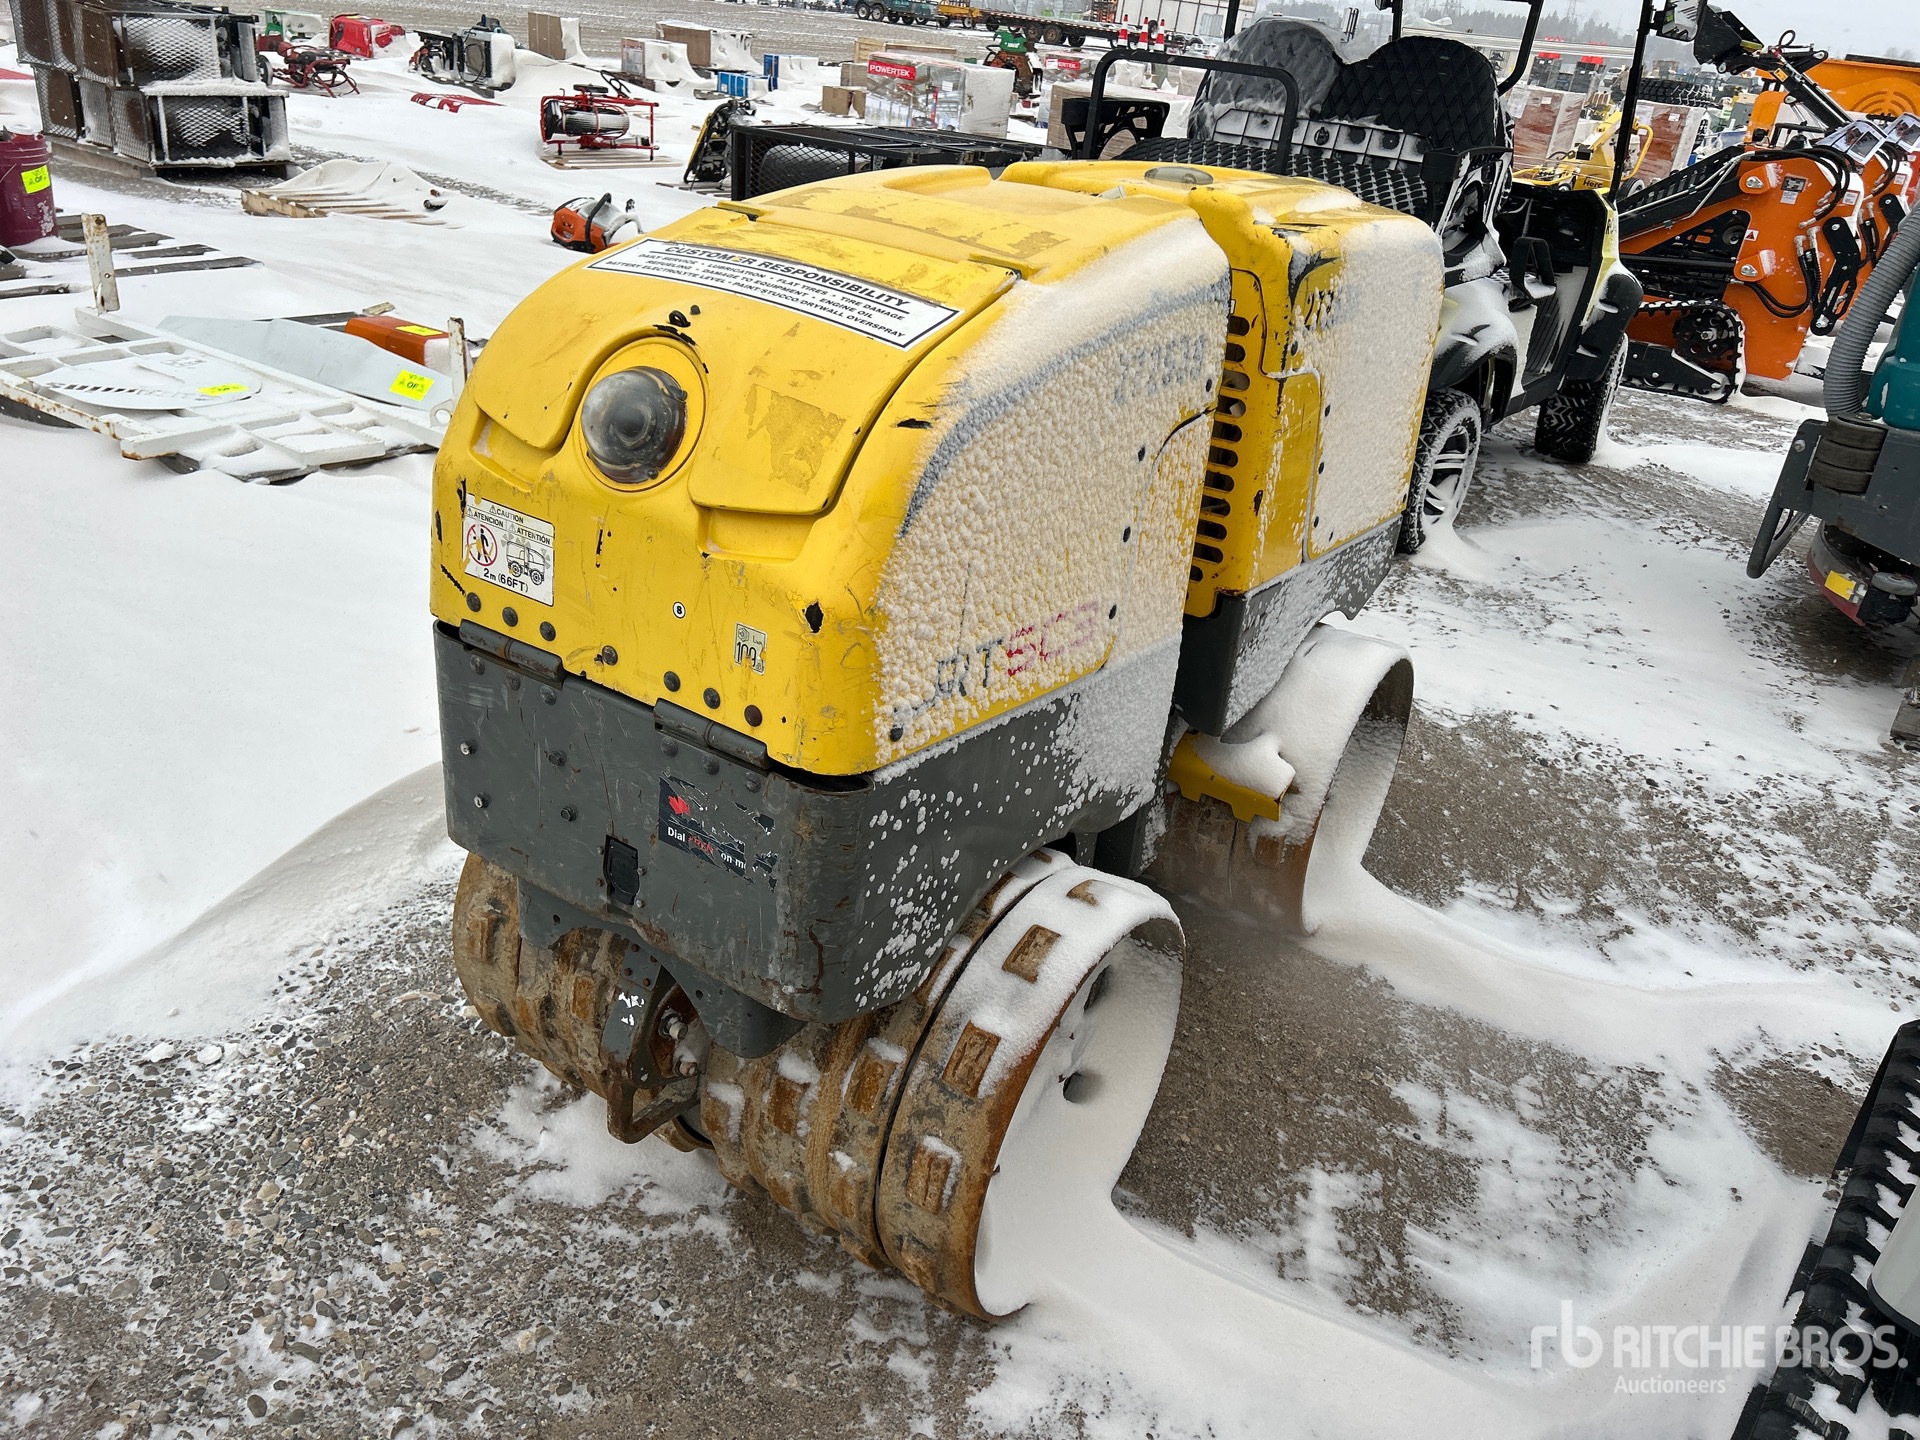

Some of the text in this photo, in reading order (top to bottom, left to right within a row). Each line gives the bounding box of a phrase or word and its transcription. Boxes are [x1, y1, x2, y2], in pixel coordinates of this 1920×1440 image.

[869, 64, 910, 77] POWERTEK
[605, 260, 643, 269] BATTERY
[642, 265, 701, 279] ELECTROLYTE
[699, 274, 727, 284] LEVEL
[845, 314, 907, 338] OVERSPRAY
[645, 260, 693, 271] REFUELING
[701, 268, 741, 280] DAMAGE
[753, 280, 810, 297] EQUIPMENT
[819, 297, 856, 313] ENGINE
[857, 309, 874, 319] OIL
[662, 256, 699, 265] SERVICE
[706, 262, 767, 279] LUBRICATION
[776, 278, 801, 288] FLAT
[801, 284, 829, 296] TIRES
[840, 296, 864, 308] TIRE
[863, 302, 906, 321] DAMAGE
[664, 246, 911, 306] CUSTOMER RESPONSIBILITY
[473, 511, 504, 528] ATENCION
[496, 508, 524, 524] CAUTION
[667, 826, 686, 842] Dial
[720, 852, 732, 864] on
